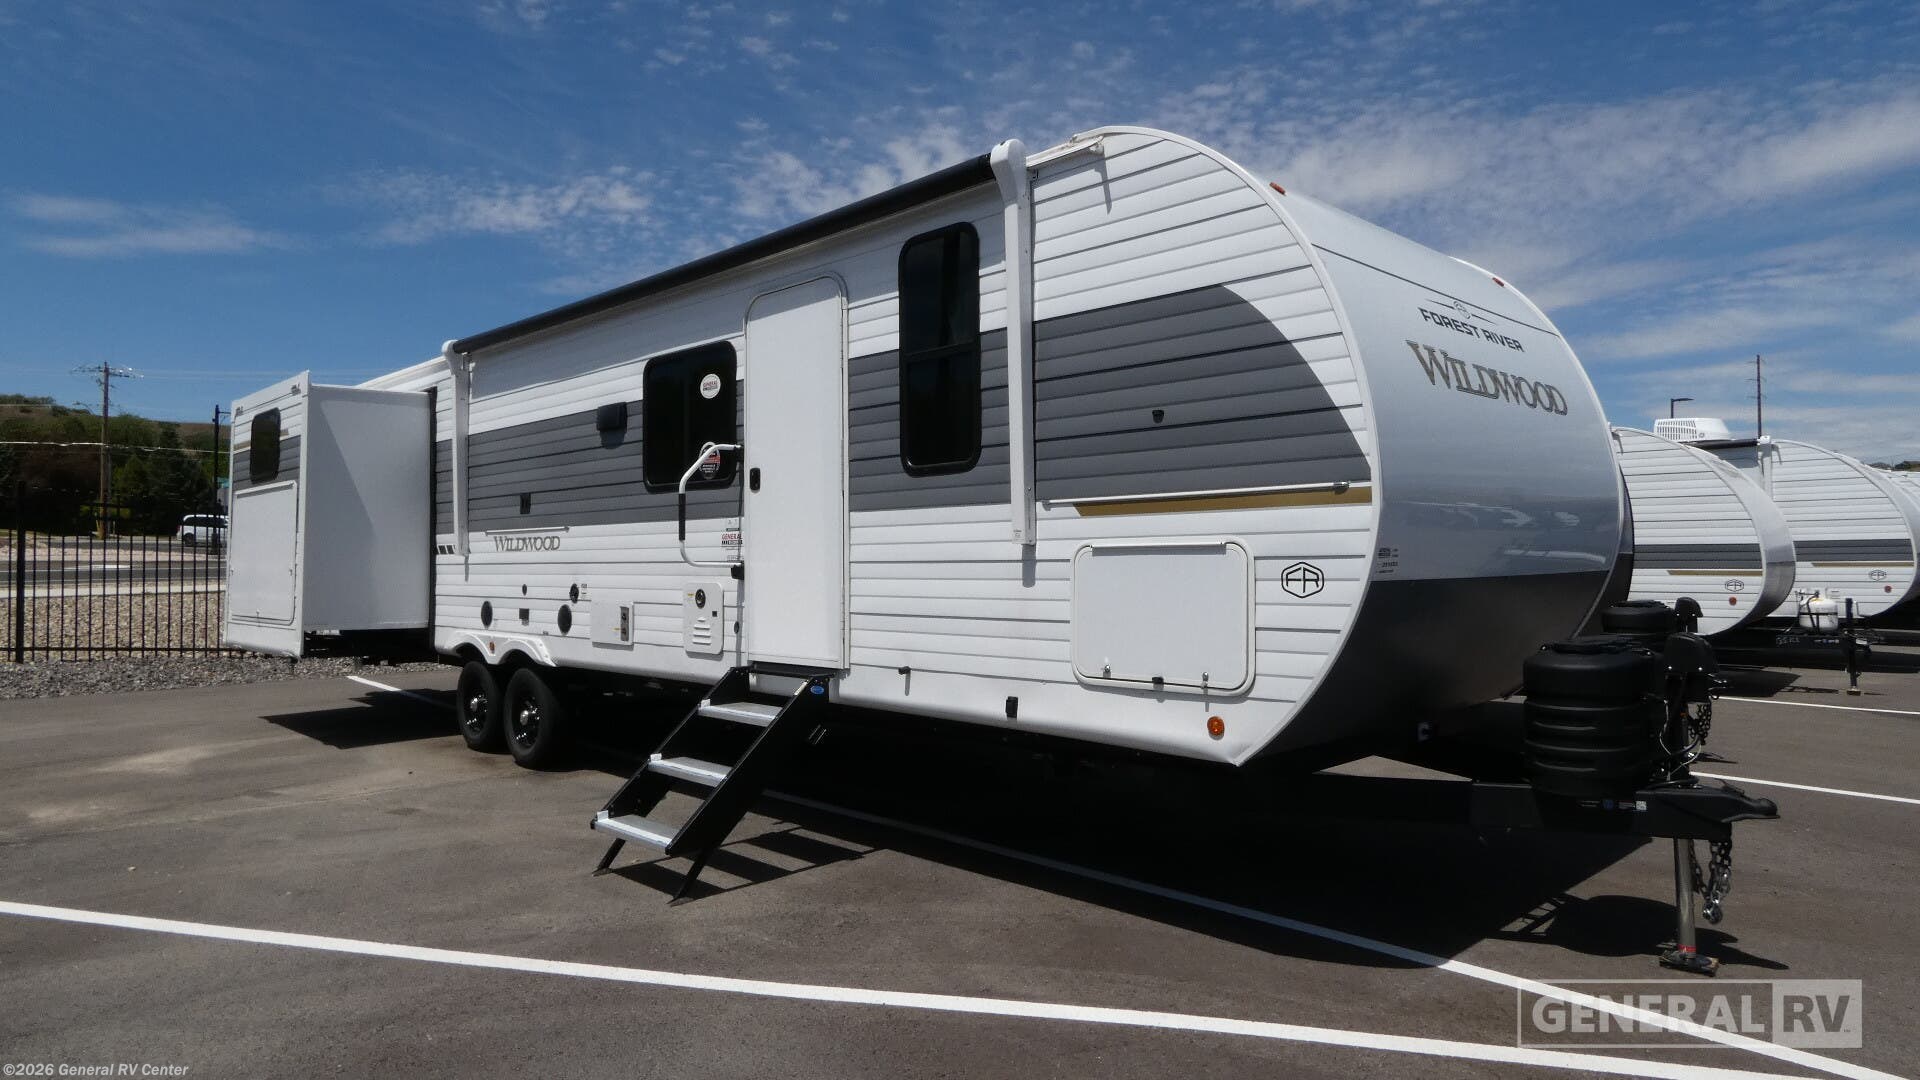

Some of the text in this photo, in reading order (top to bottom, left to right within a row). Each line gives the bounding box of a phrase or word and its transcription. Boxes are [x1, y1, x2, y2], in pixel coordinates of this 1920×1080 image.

[1417, 306, 1525, 352] FOREST RIVER
[1405, 339, 1568, 416] WILDWOOD
[494, 536, 560, 551] WILDWOOD
